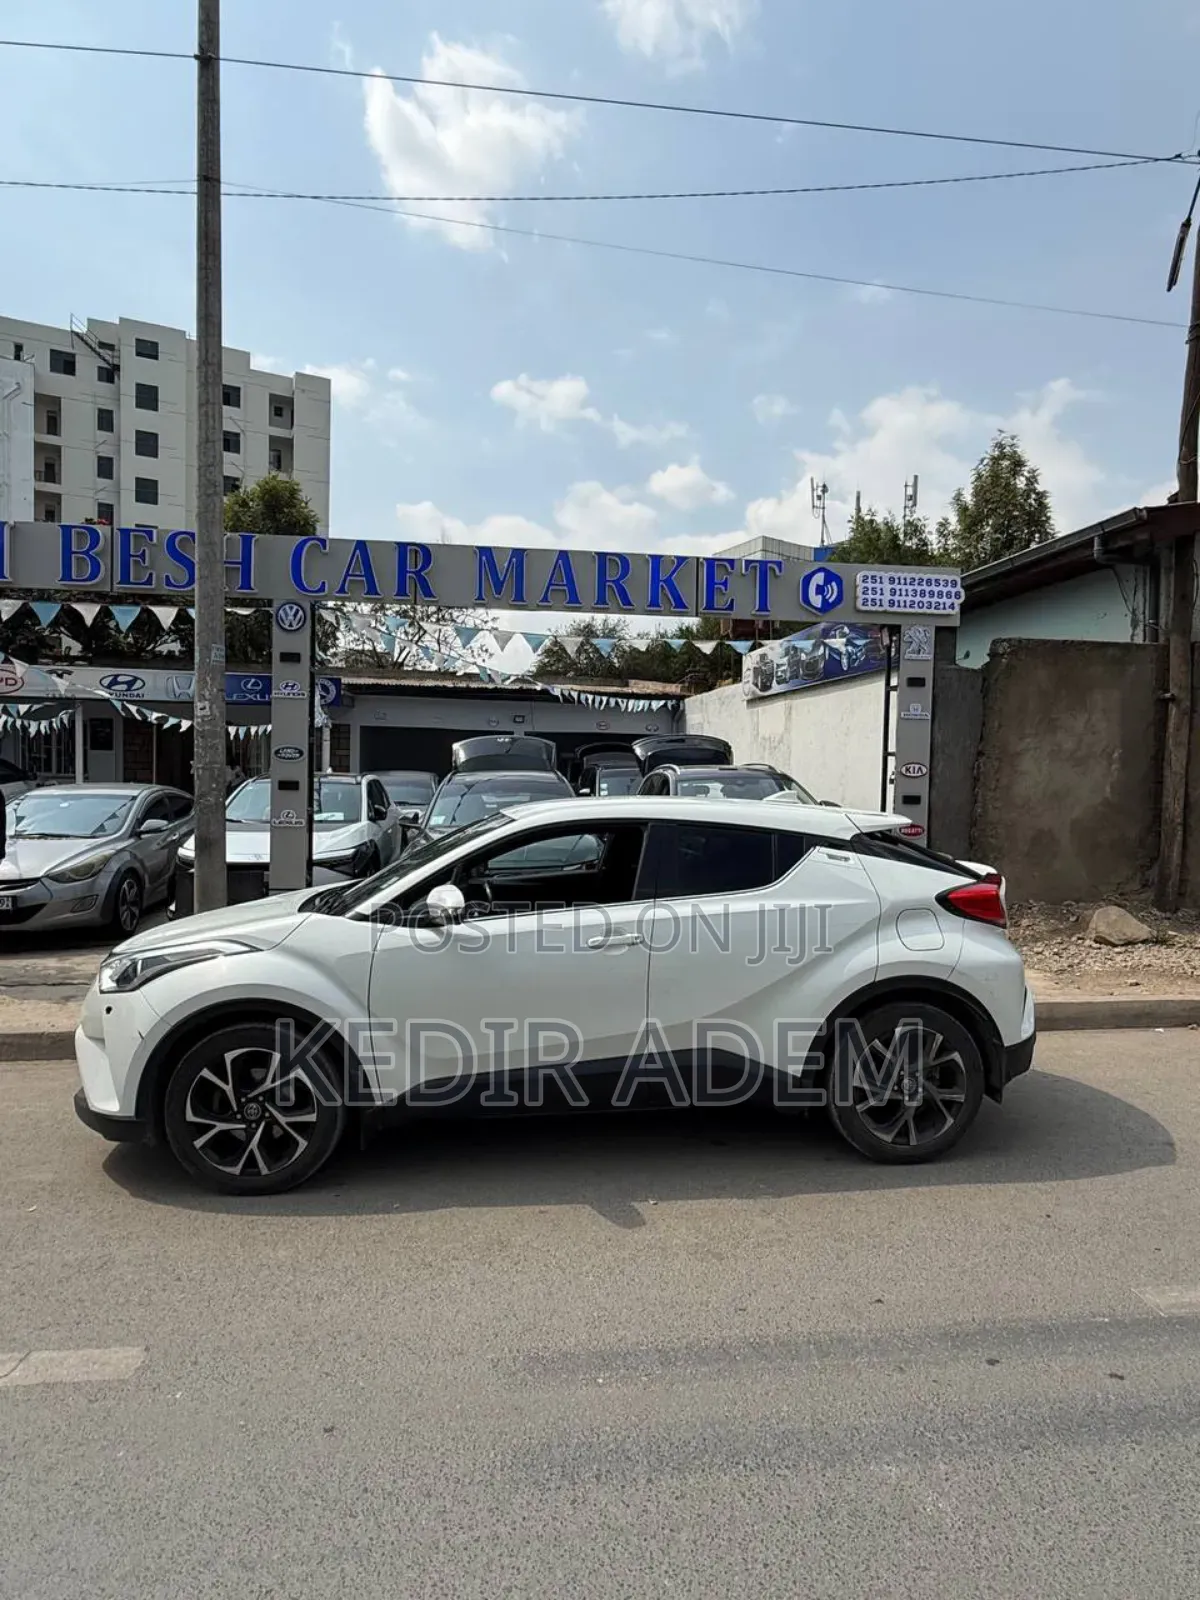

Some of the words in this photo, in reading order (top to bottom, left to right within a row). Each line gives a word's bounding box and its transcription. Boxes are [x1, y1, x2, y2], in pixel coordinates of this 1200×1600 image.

[58, 523, 257, 593] BESH
[290, 536, 437, 599] CAR
[474, 546, 784, 616] MARKET
[861, 575, 884, 584] 251
[861, 586, 885, 596] 251
[861, 598, 884, 607] 251
[888, 599, 955, 610] 911203214
[904, 765, 924, 775] KIA
